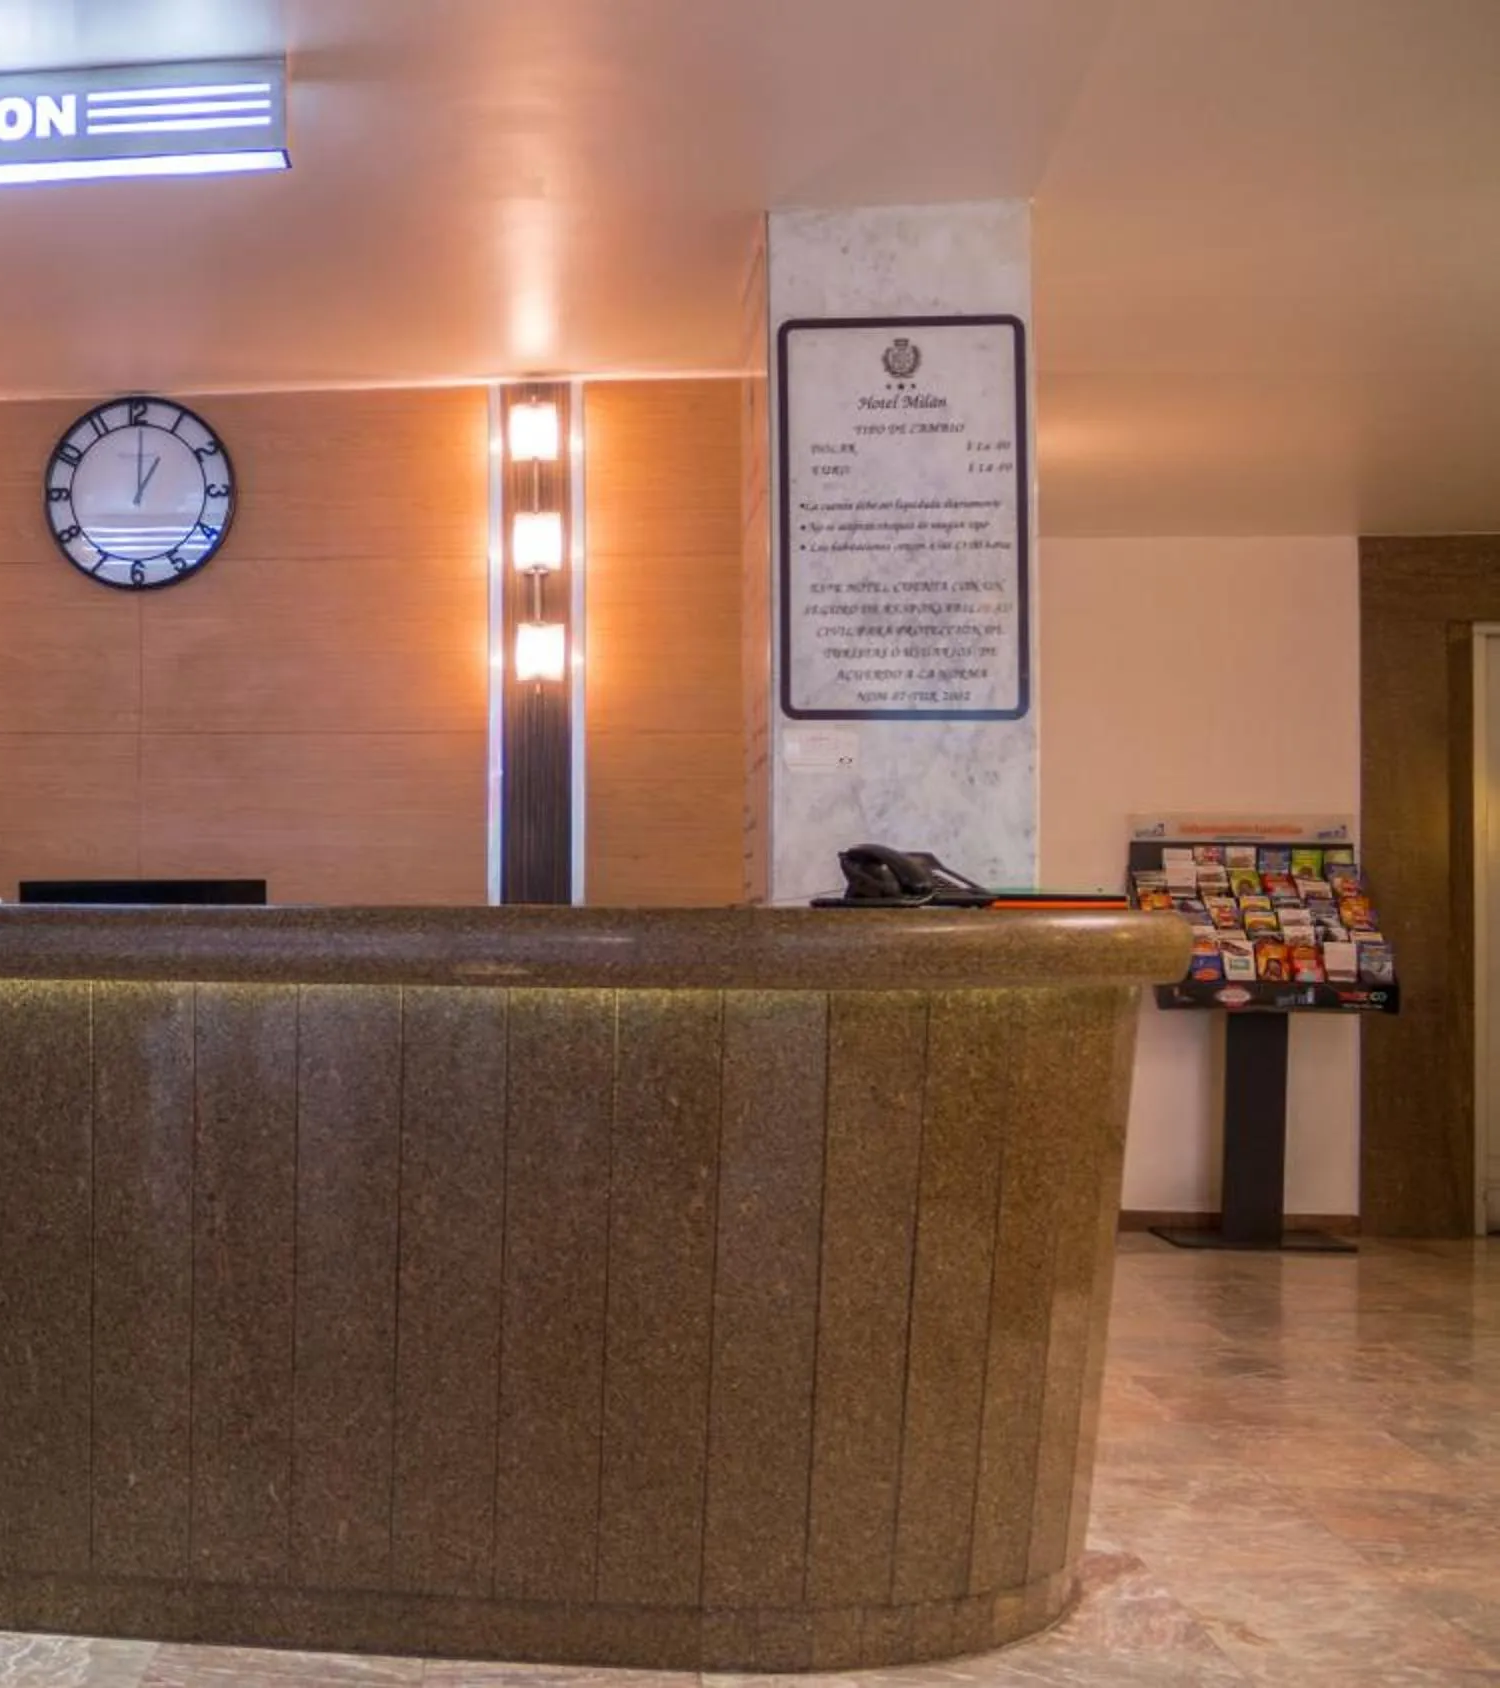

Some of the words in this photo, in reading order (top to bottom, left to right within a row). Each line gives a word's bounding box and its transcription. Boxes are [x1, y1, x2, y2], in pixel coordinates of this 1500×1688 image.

[856, 395, 898, 411] Hotel
[129, 402, 149, 426] 12
[205, 483, 230, 498] 3
[58, 524, 82, 544] 8
